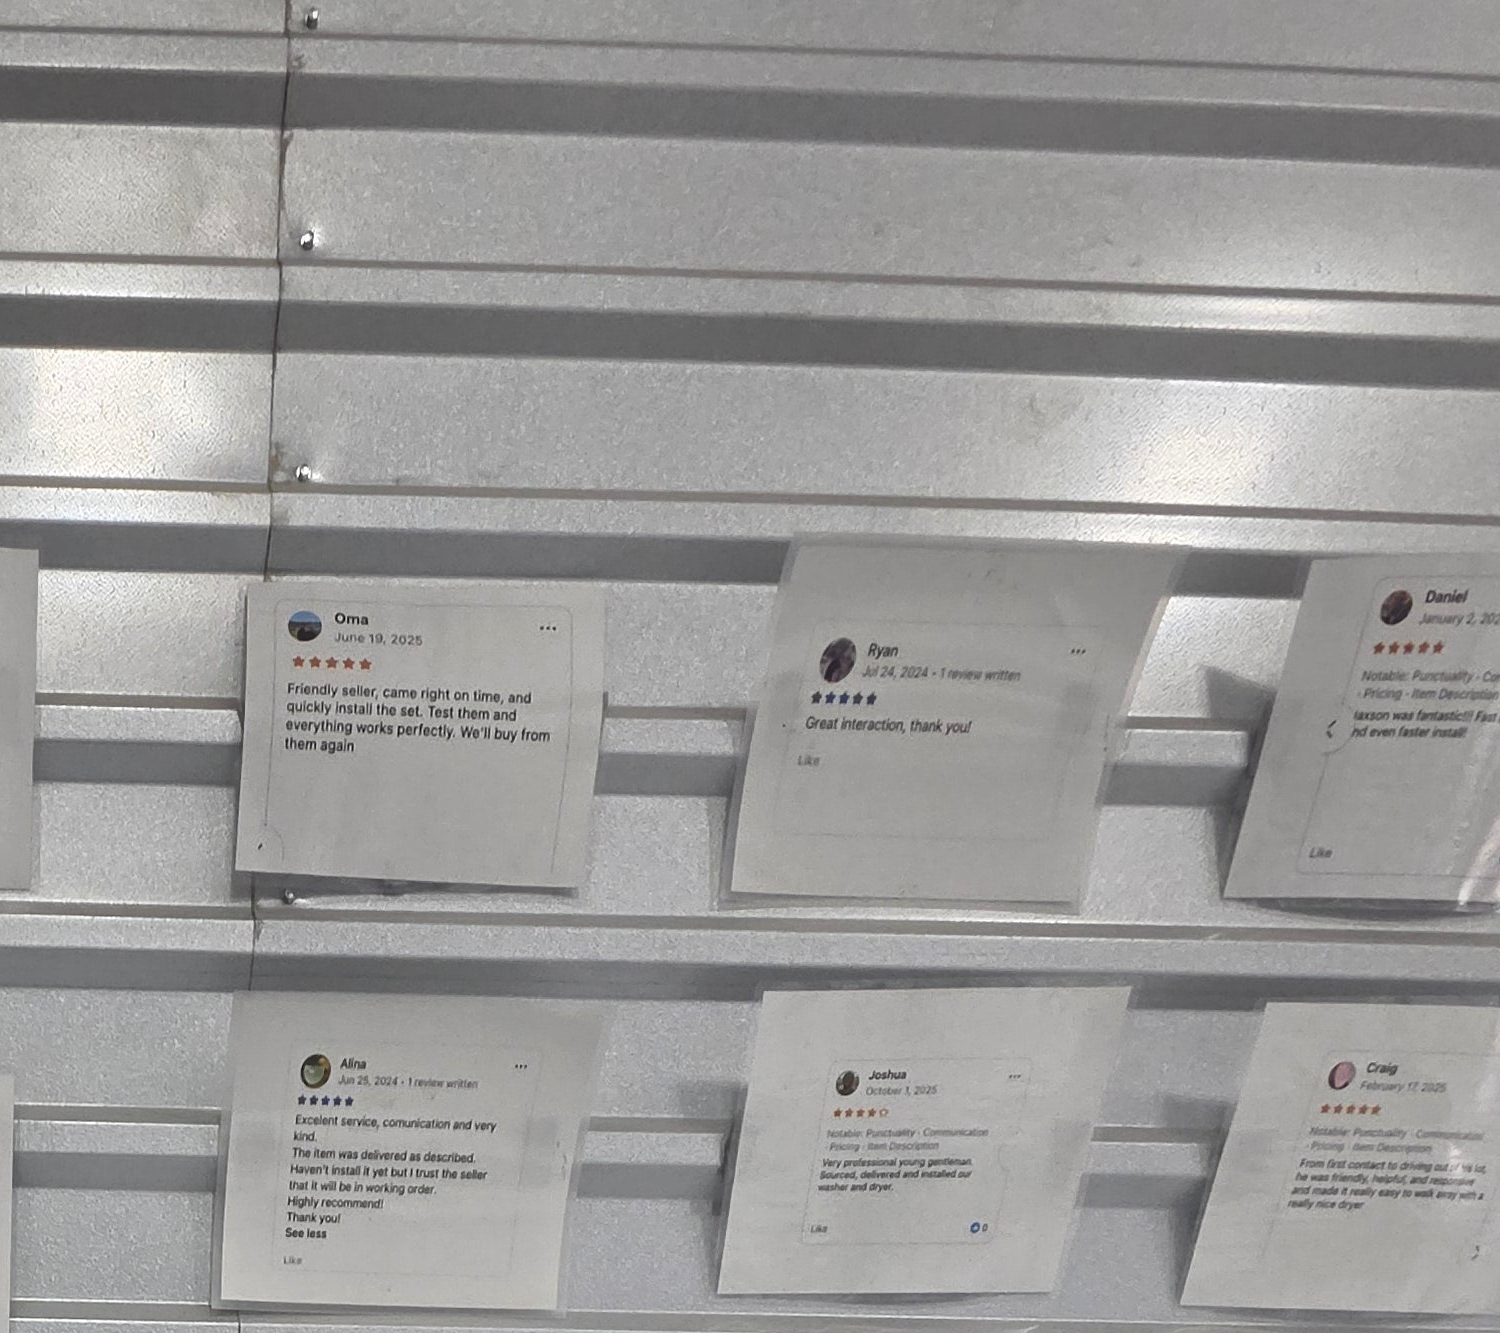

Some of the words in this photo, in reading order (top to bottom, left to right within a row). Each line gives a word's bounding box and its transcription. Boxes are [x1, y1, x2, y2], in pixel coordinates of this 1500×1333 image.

[1424, 589, 1469, 604] Daniel
[334, 612, 369, 625] Oma
[334, 632, 366, 643] June
[368, 633, 386, 645] 19,
[867, 642, 899, 660] Ryan
[287, 682, 338, 698] Friendly
[341, 684, 378, 701] seller,
[382, 688, 417, 700] came
[420, 687, 450, 703] right
[453, 691, 469, 702] on
[473, 689, 504, 705] time,
[507, 691, 532, 704] and
[805, 715, 839, 730] Great
[840, 716, 906, 734] interaction,
[909, 718, 943, 733] thank
[284, 737, 317, 751] them
[319, 739, 354, 755] again
[339, 1057, 367, 1070] Alina
[1366, 1061, 1399, 1076] Craig
[868, 1069, 907, 1080] Joshua
[849, 1182, 868, 1192] and
[287, 1195, 320, 1210] Highly
[286, 1211, 317, 1223] Thank
[284, 1226, 305, 1238] See
[306, 1227, 327, 1239] less
